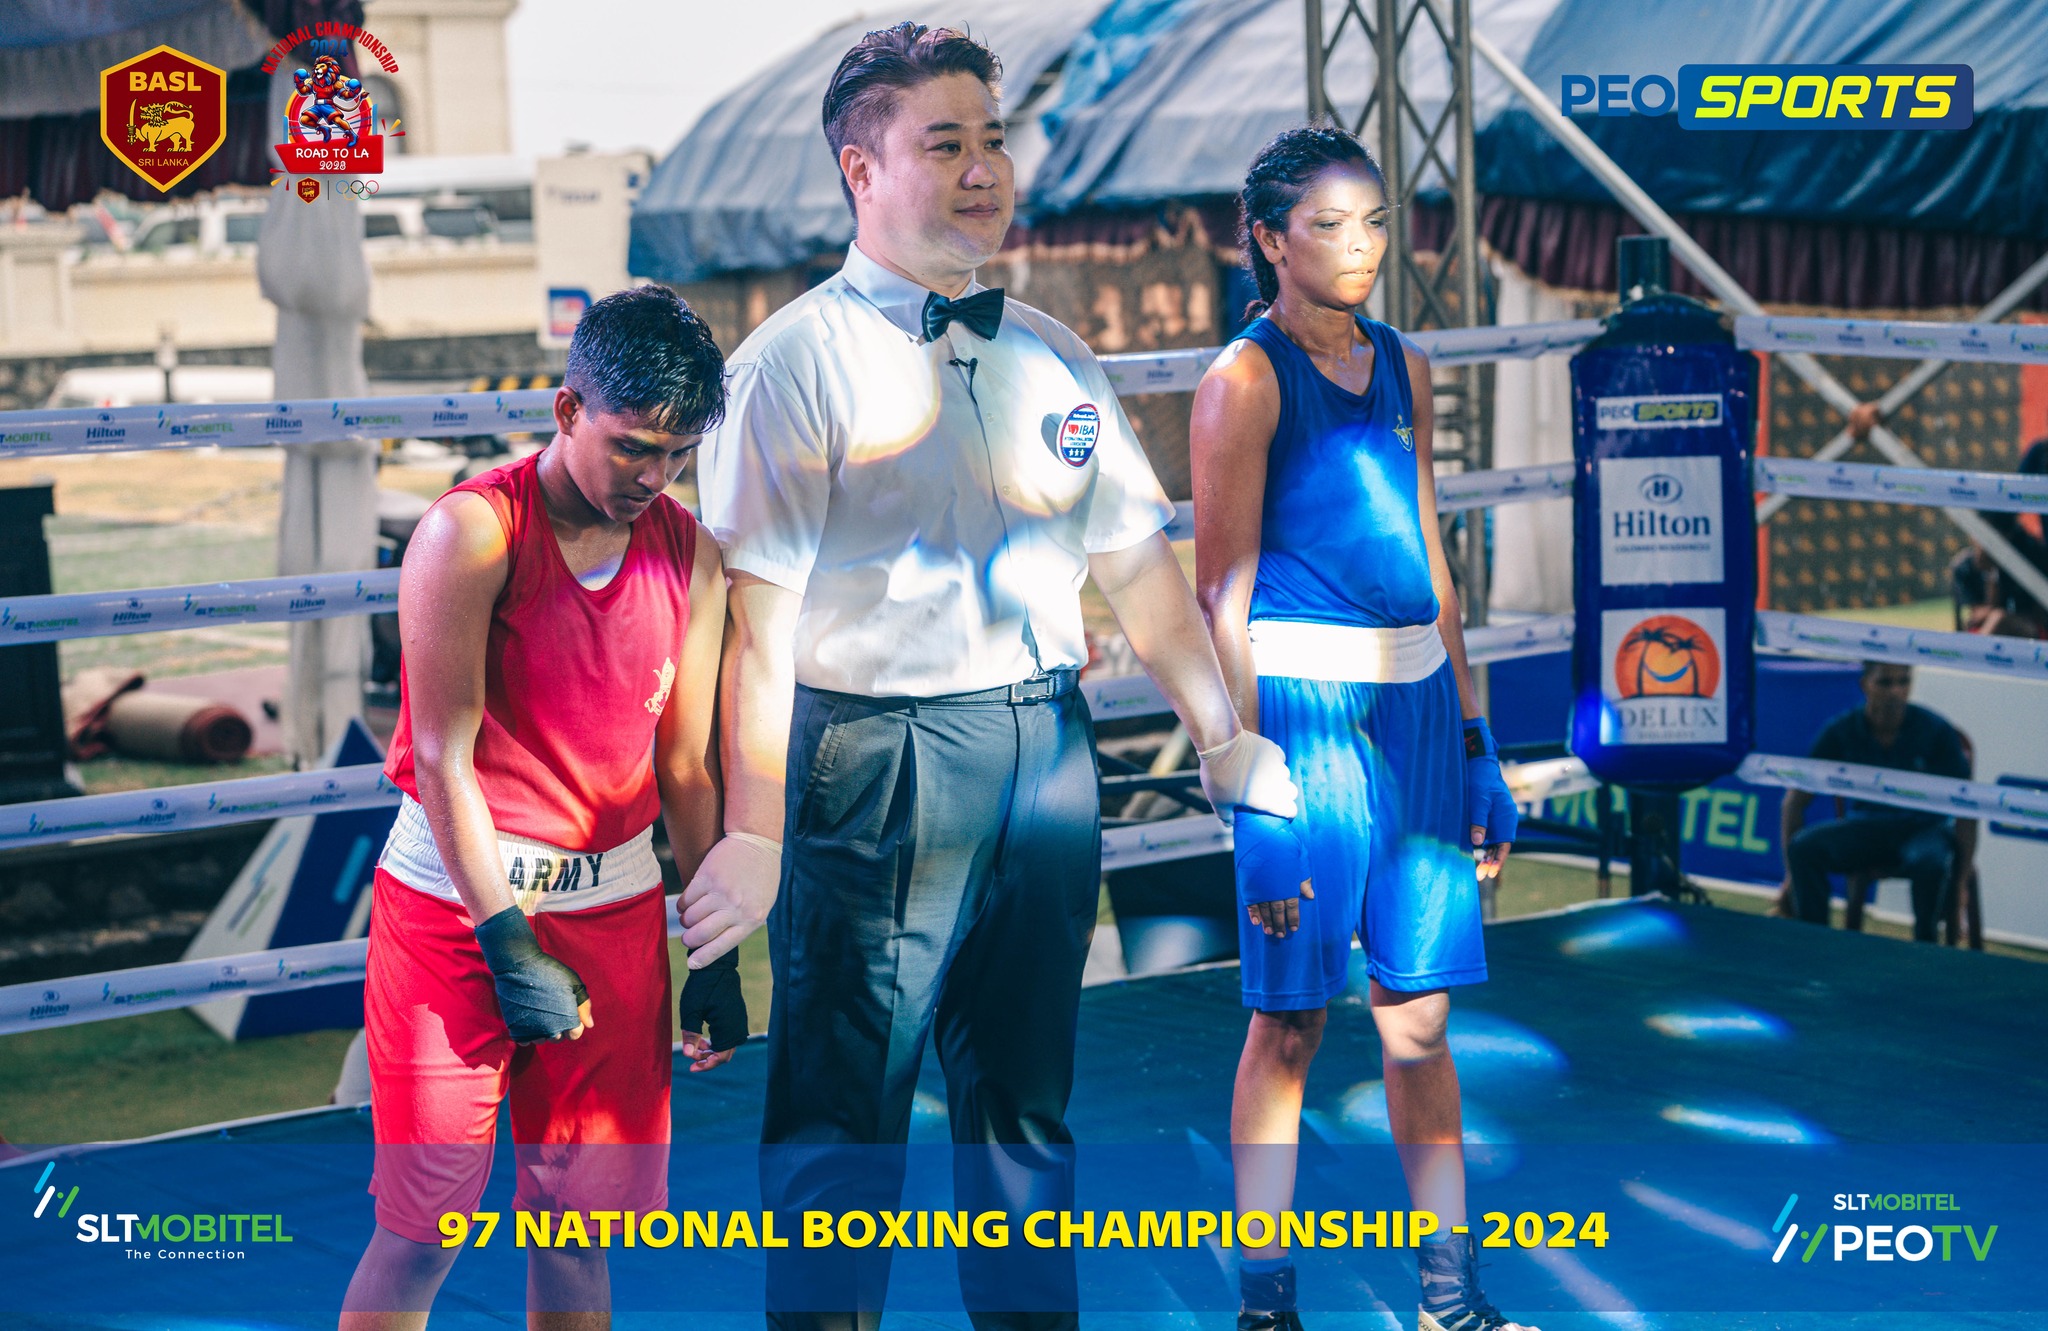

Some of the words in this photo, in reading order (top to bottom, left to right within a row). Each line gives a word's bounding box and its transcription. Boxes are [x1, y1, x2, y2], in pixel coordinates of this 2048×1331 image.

[433, 411, 469, 422] Hilton
[265, 417, 303, 430] Hilton
[86, 427, 126, 439] Hilton
[1079, 424, 1095, 436] IBA
[1613, 510, 1711, 537] Hilton
[508, 852, 604, 892] ARMY
